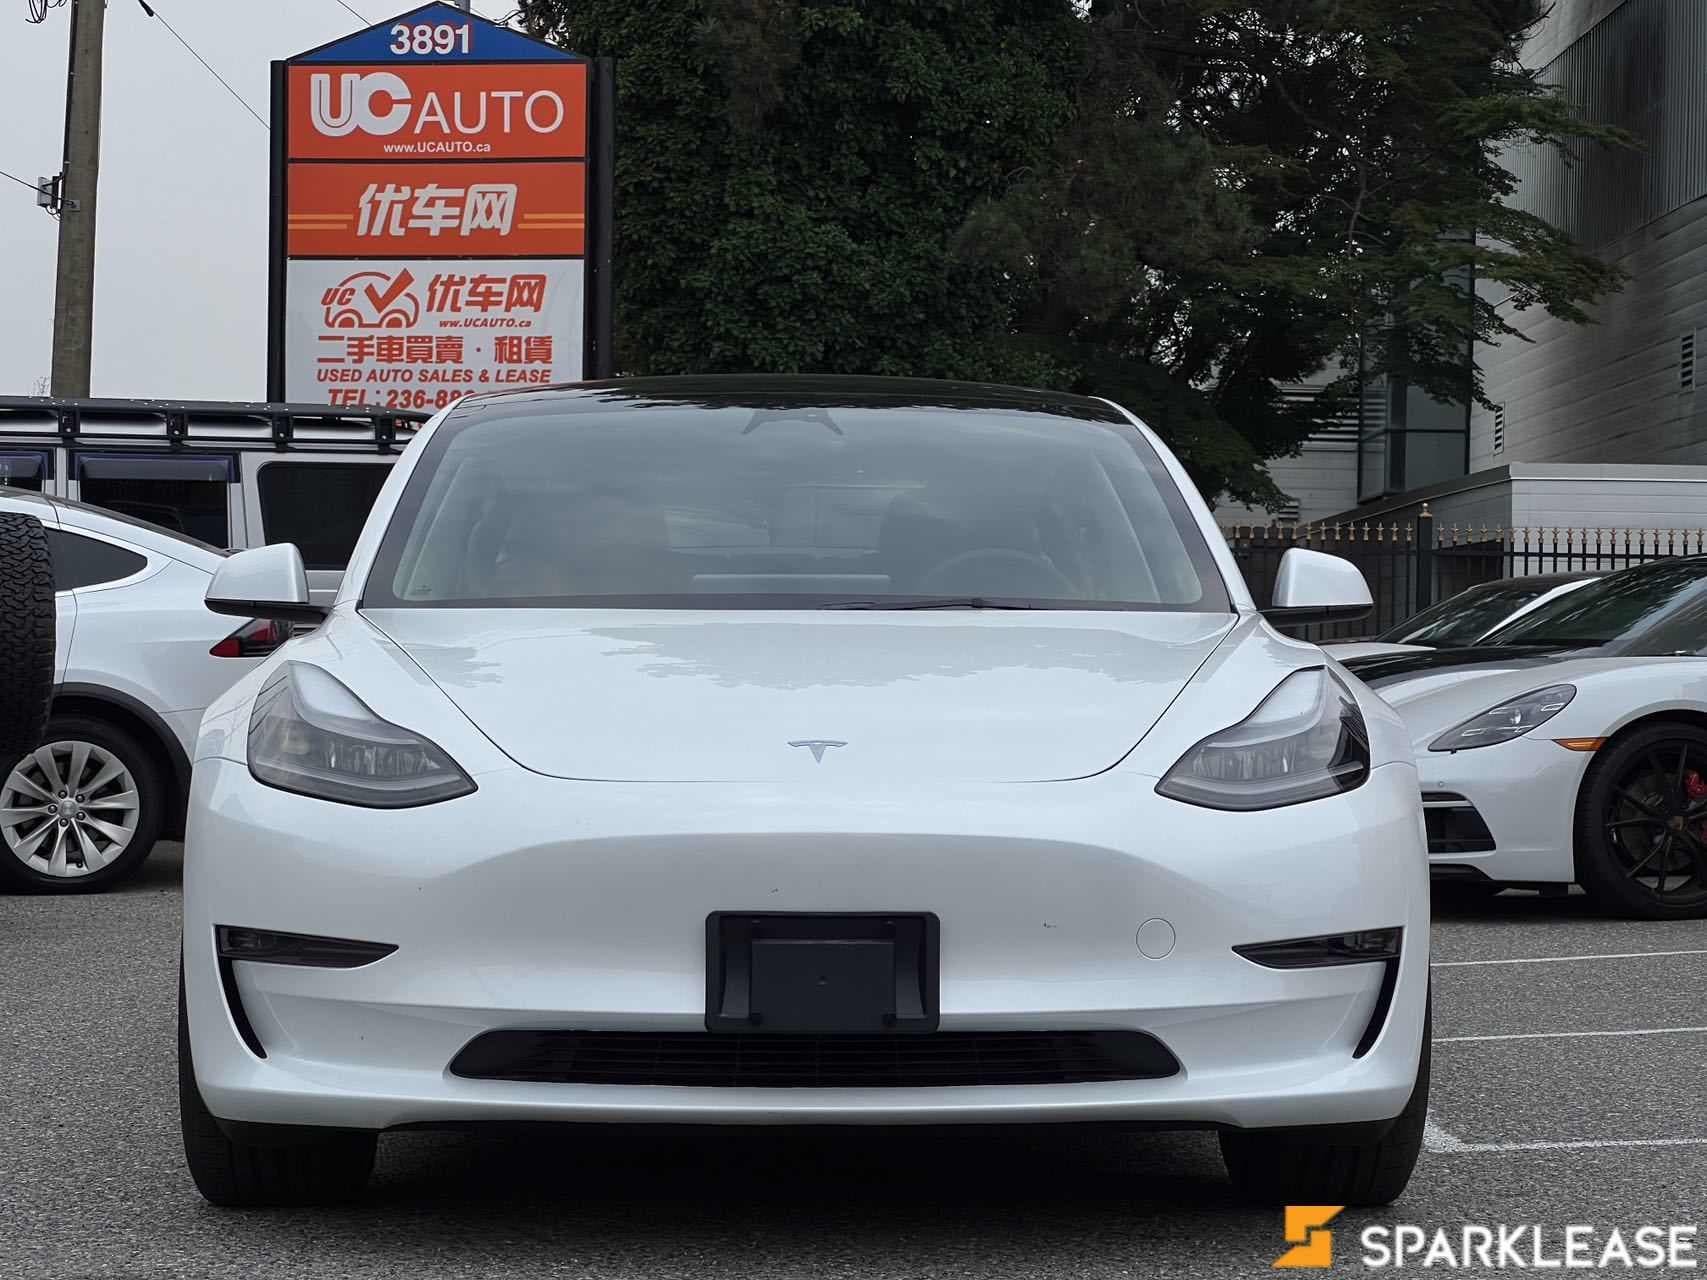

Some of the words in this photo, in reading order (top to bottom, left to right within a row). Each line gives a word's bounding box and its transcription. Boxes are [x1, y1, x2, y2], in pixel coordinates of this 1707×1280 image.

[390, 24, 470, 54] 3891
[383, 141, 491, 153] www.UCAUTO.ca
[356, 183, 518, 237] 优车网
[426, 274, 547, 313] 优车网
[317, 369, 361, 383] USED
[366, 369, 413, 383] AUTO
[418, 369, 473, 383] SALES
[479, 369, 490, 383] &
[495, 369, 552, 383] LEASE
[386, 389, 475, 409] 236-88
